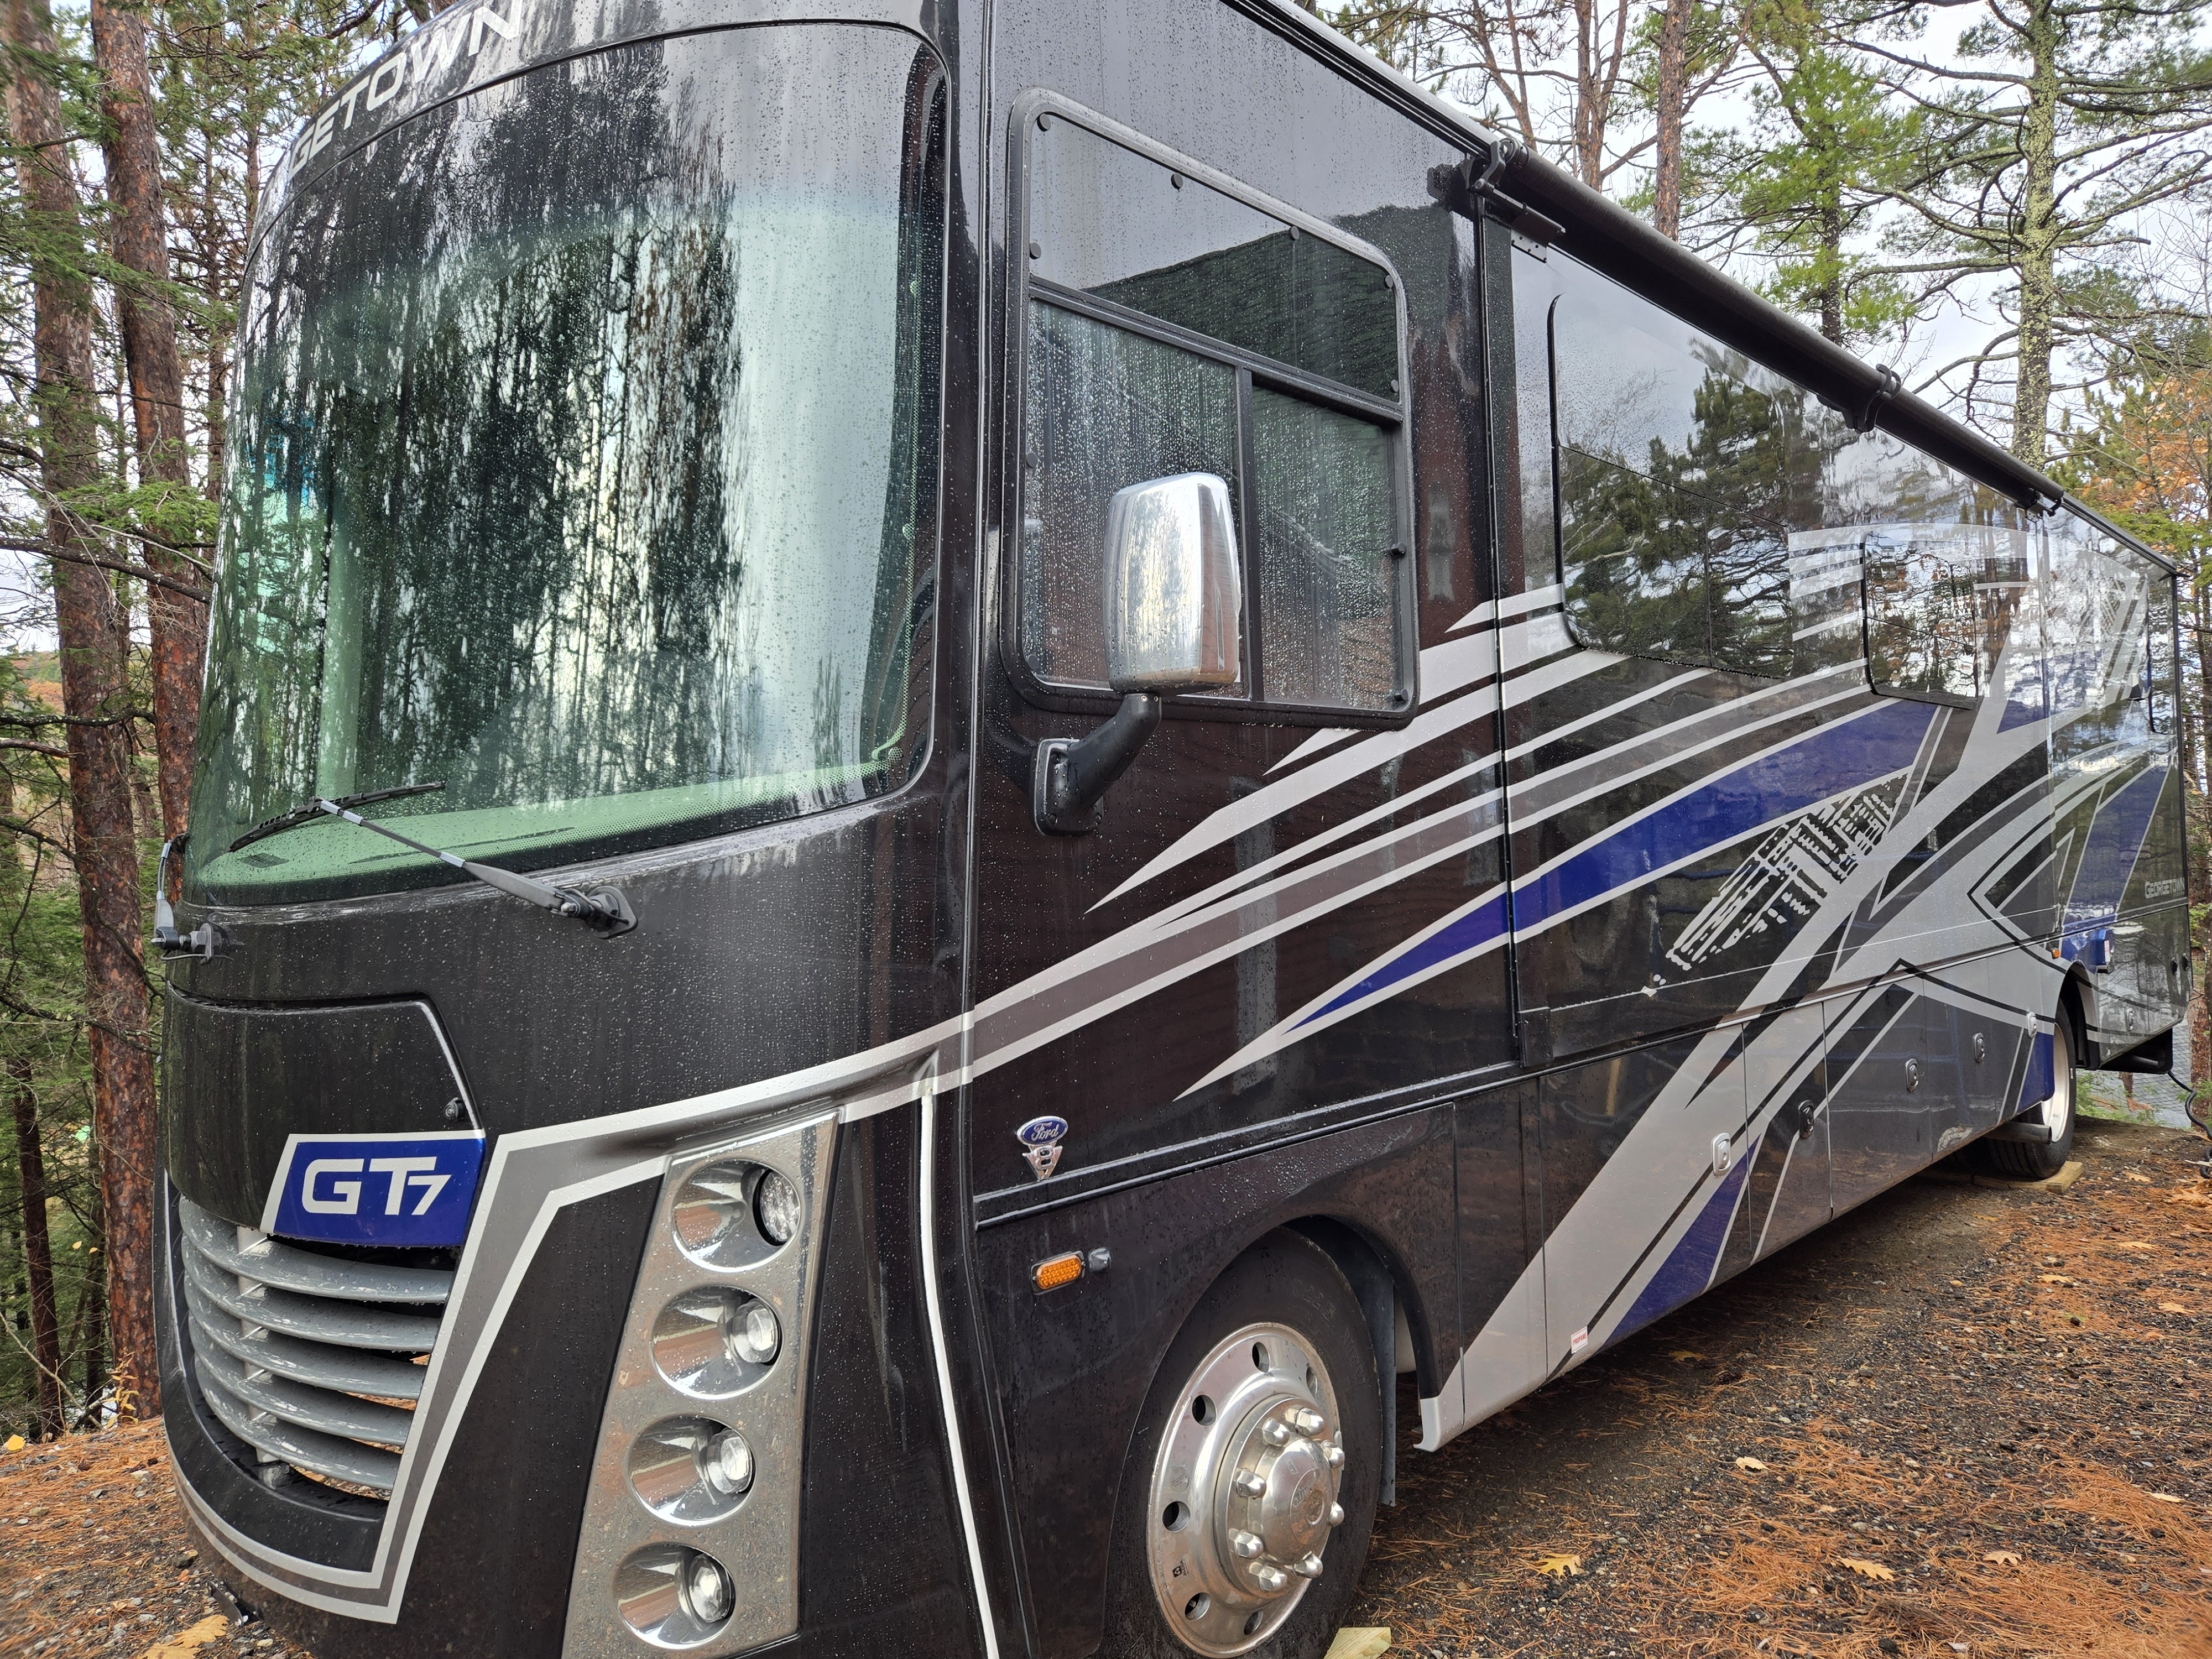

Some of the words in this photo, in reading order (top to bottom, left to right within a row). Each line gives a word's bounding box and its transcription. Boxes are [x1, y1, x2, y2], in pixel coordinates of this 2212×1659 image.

[2145, 877, 2185, 899] GEORGETOWN
[1031, 1121, 1060, 1141] Ford
[302, 1156, 452, 1215] GT7
[1573, 1332, 1587, 1346] PROPANE
